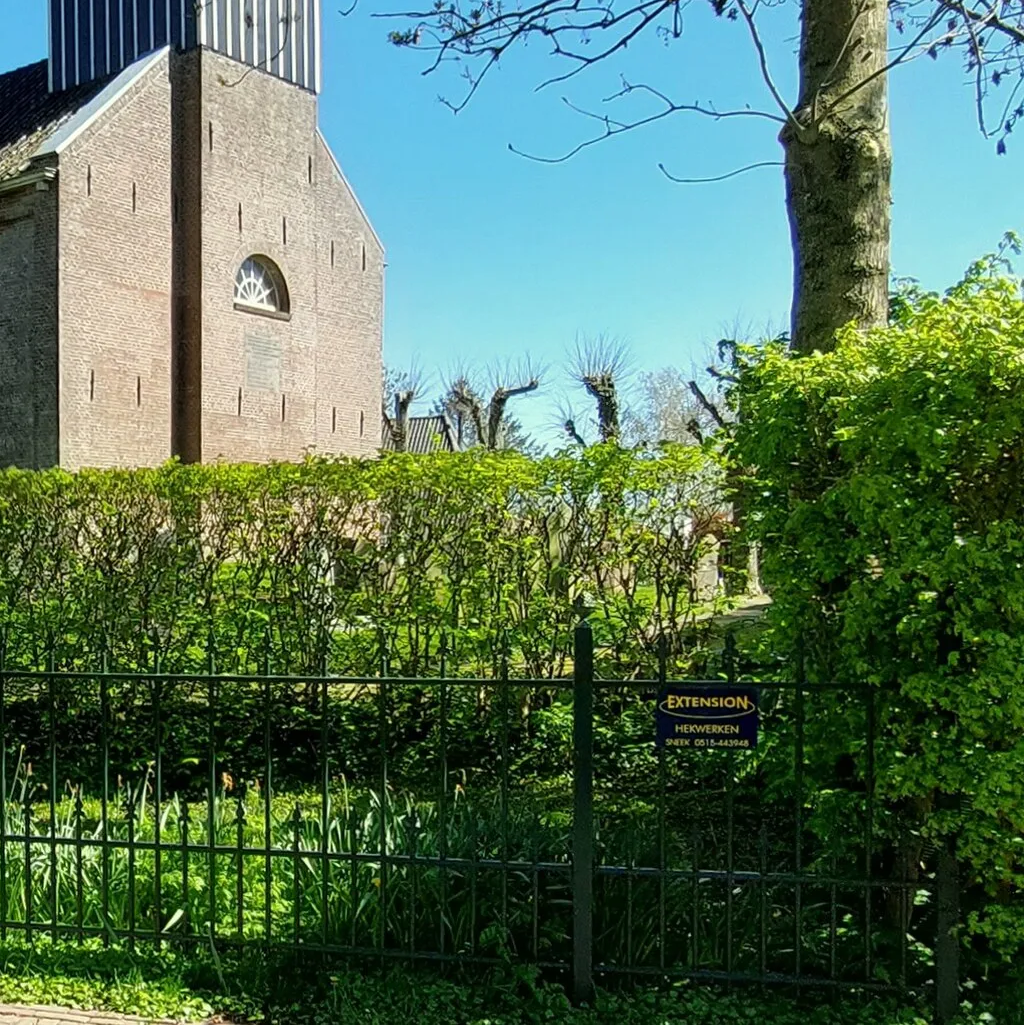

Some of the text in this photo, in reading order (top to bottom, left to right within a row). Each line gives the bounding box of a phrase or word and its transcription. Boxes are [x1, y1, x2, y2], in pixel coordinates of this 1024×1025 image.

[667, 694, 748, 710] EXTENSION
[675, 724, 739, 734] HEKWERKEN
[665, 738, 690, 746] SNEEK
